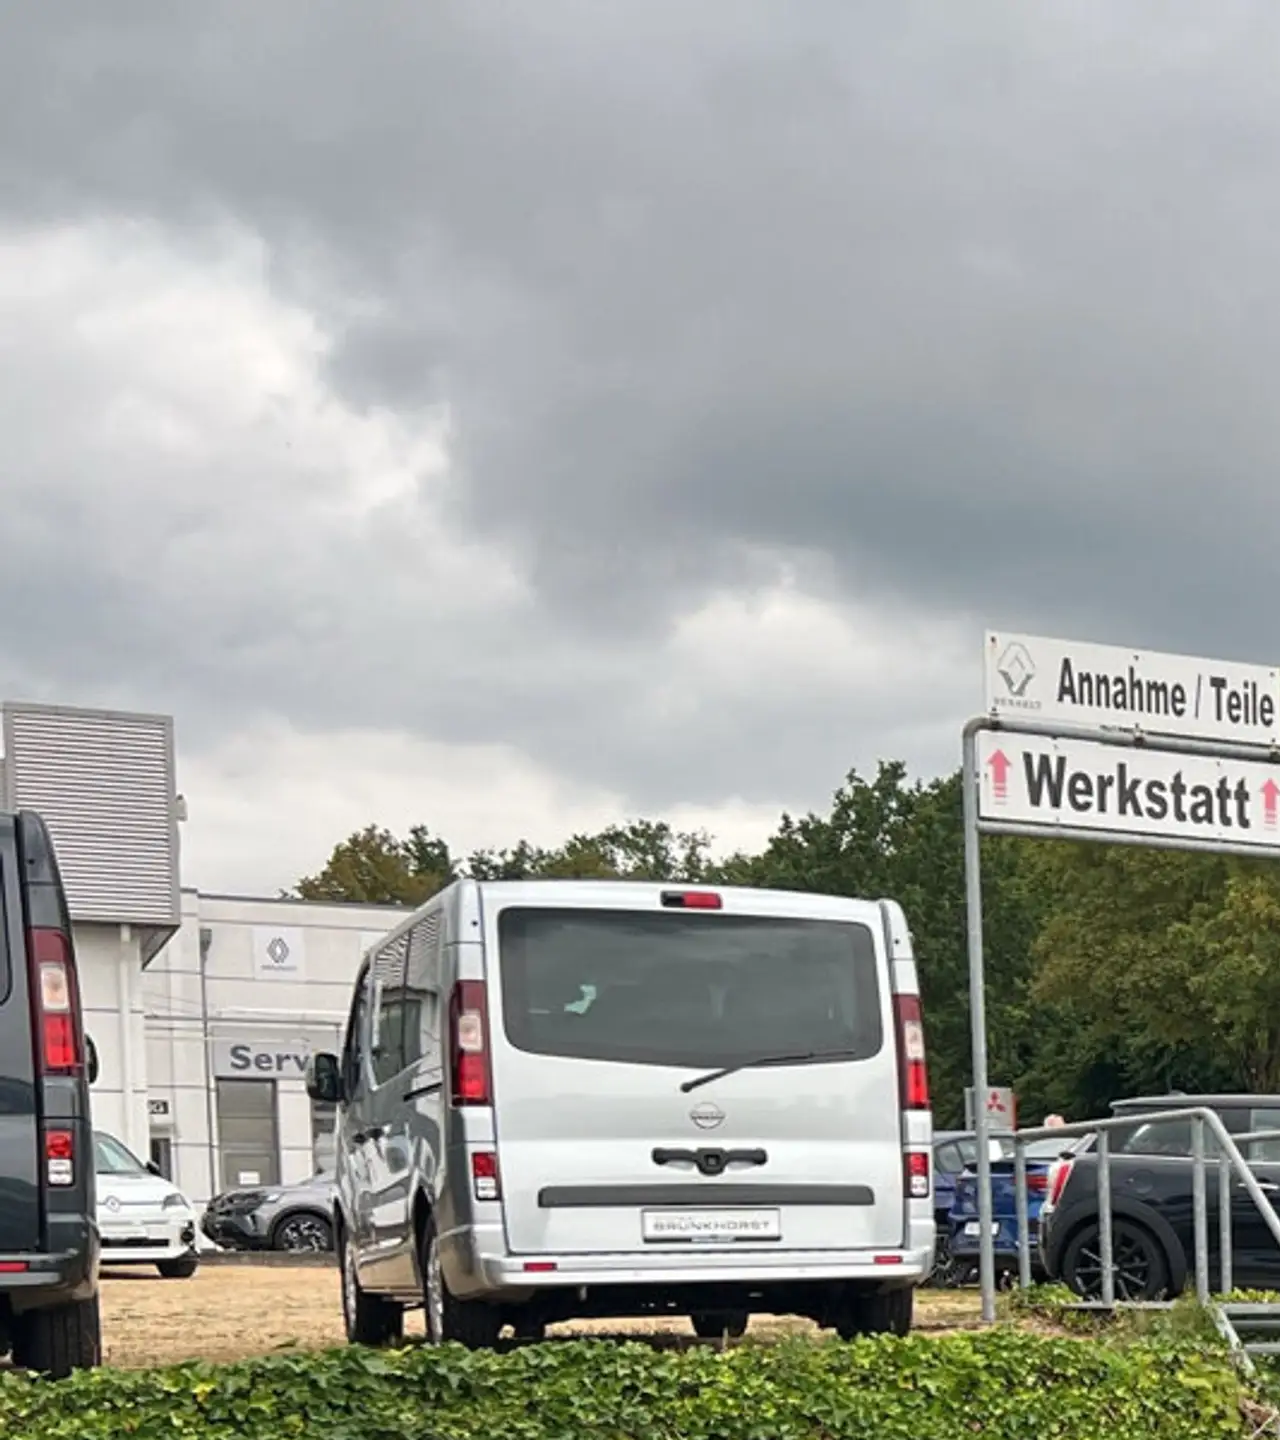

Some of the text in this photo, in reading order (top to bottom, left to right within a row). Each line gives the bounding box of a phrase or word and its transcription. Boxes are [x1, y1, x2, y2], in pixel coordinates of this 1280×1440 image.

[1057, 658, 1275, 727] Annahme / Teile
[1022, 751, 1251, 829] Werkstatt
[229, 1045, 311, 1072] Serv
